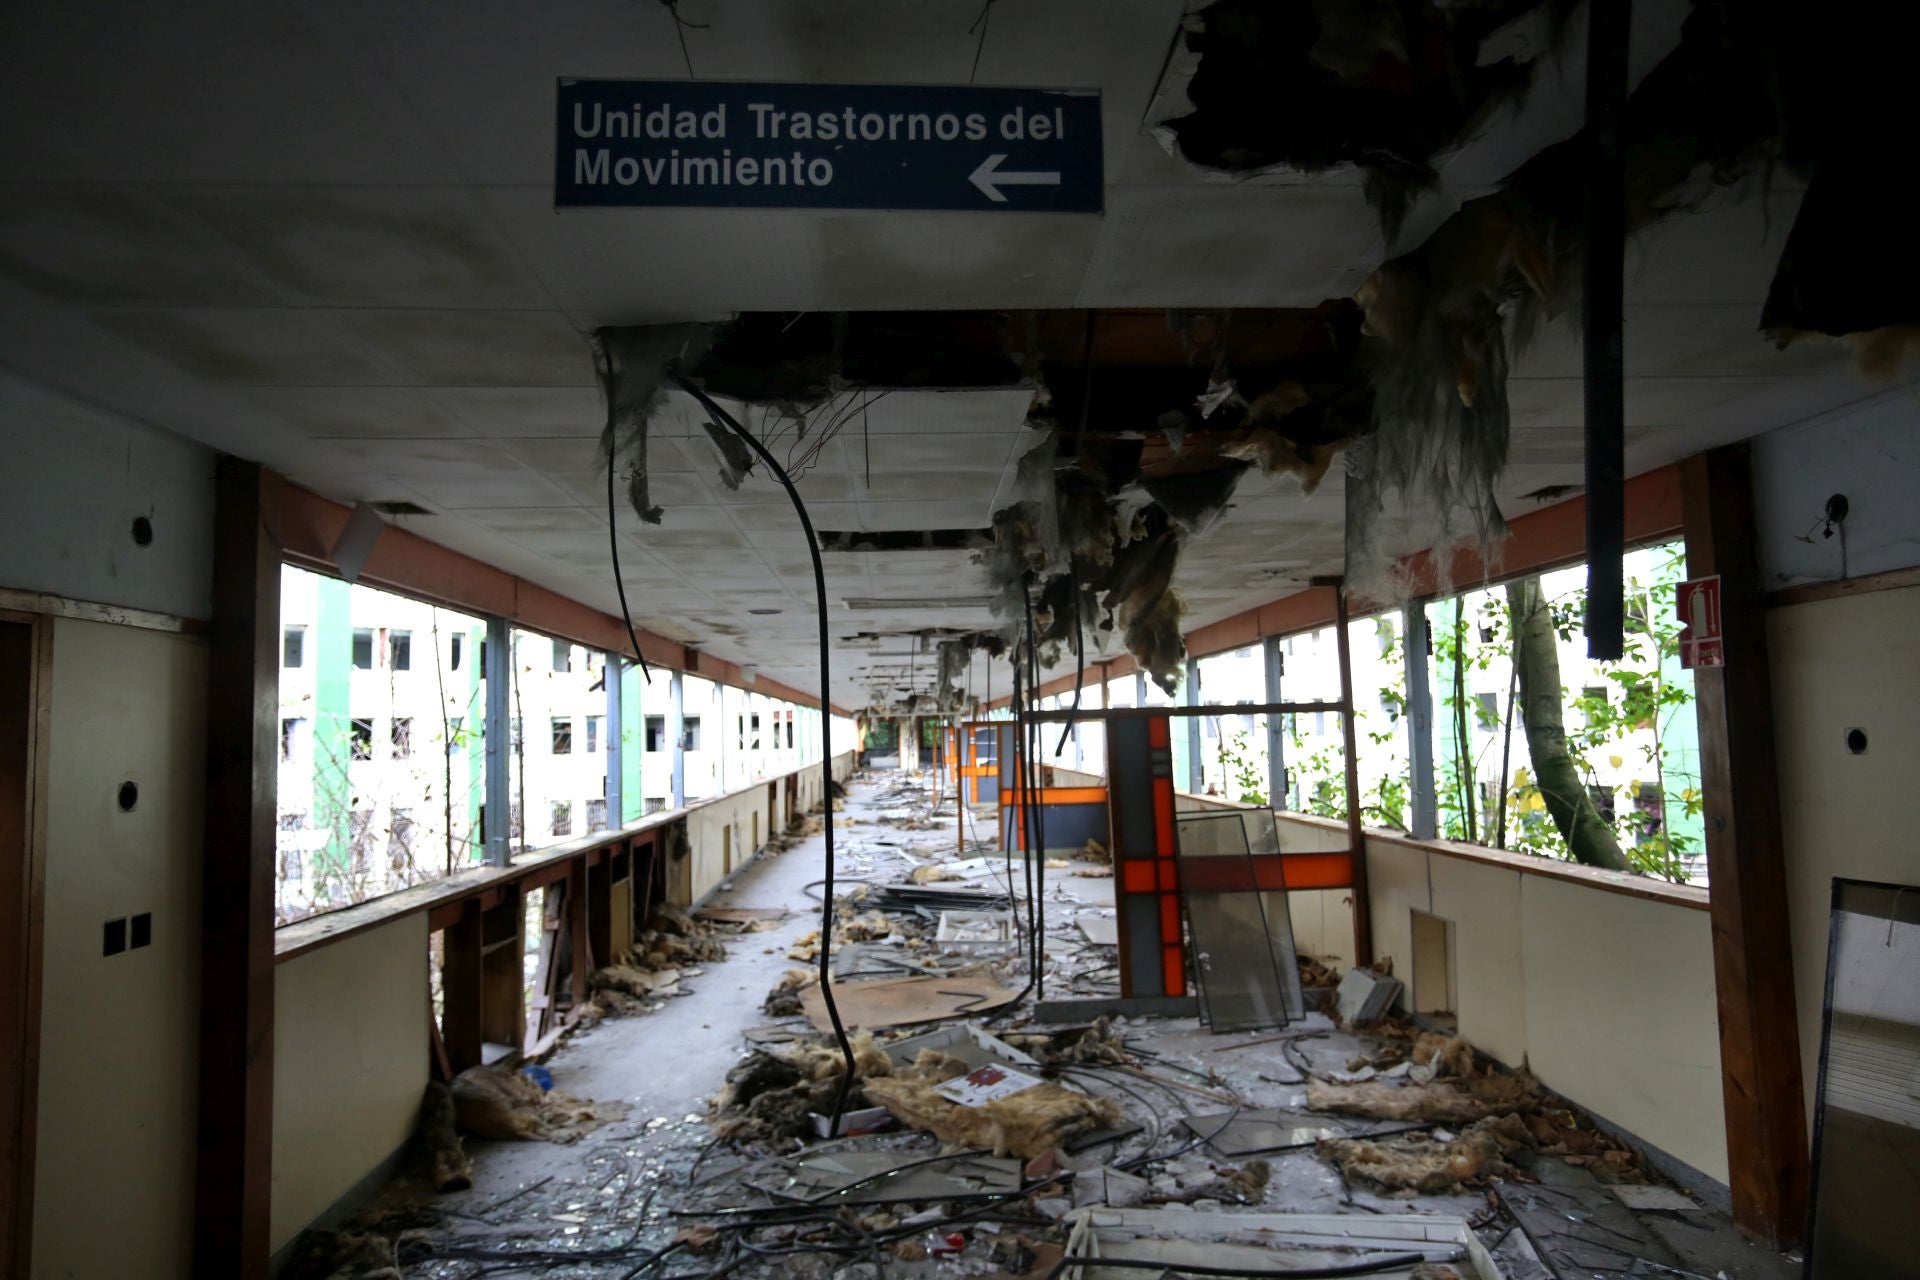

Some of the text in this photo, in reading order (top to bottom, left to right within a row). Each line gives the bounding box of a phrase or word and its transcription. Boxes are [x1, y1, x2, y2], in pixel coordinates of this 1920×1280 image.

[574, 103, 1064, 141] Unidad Trastornos del
[575, 149, 833, 186] Movimiento
